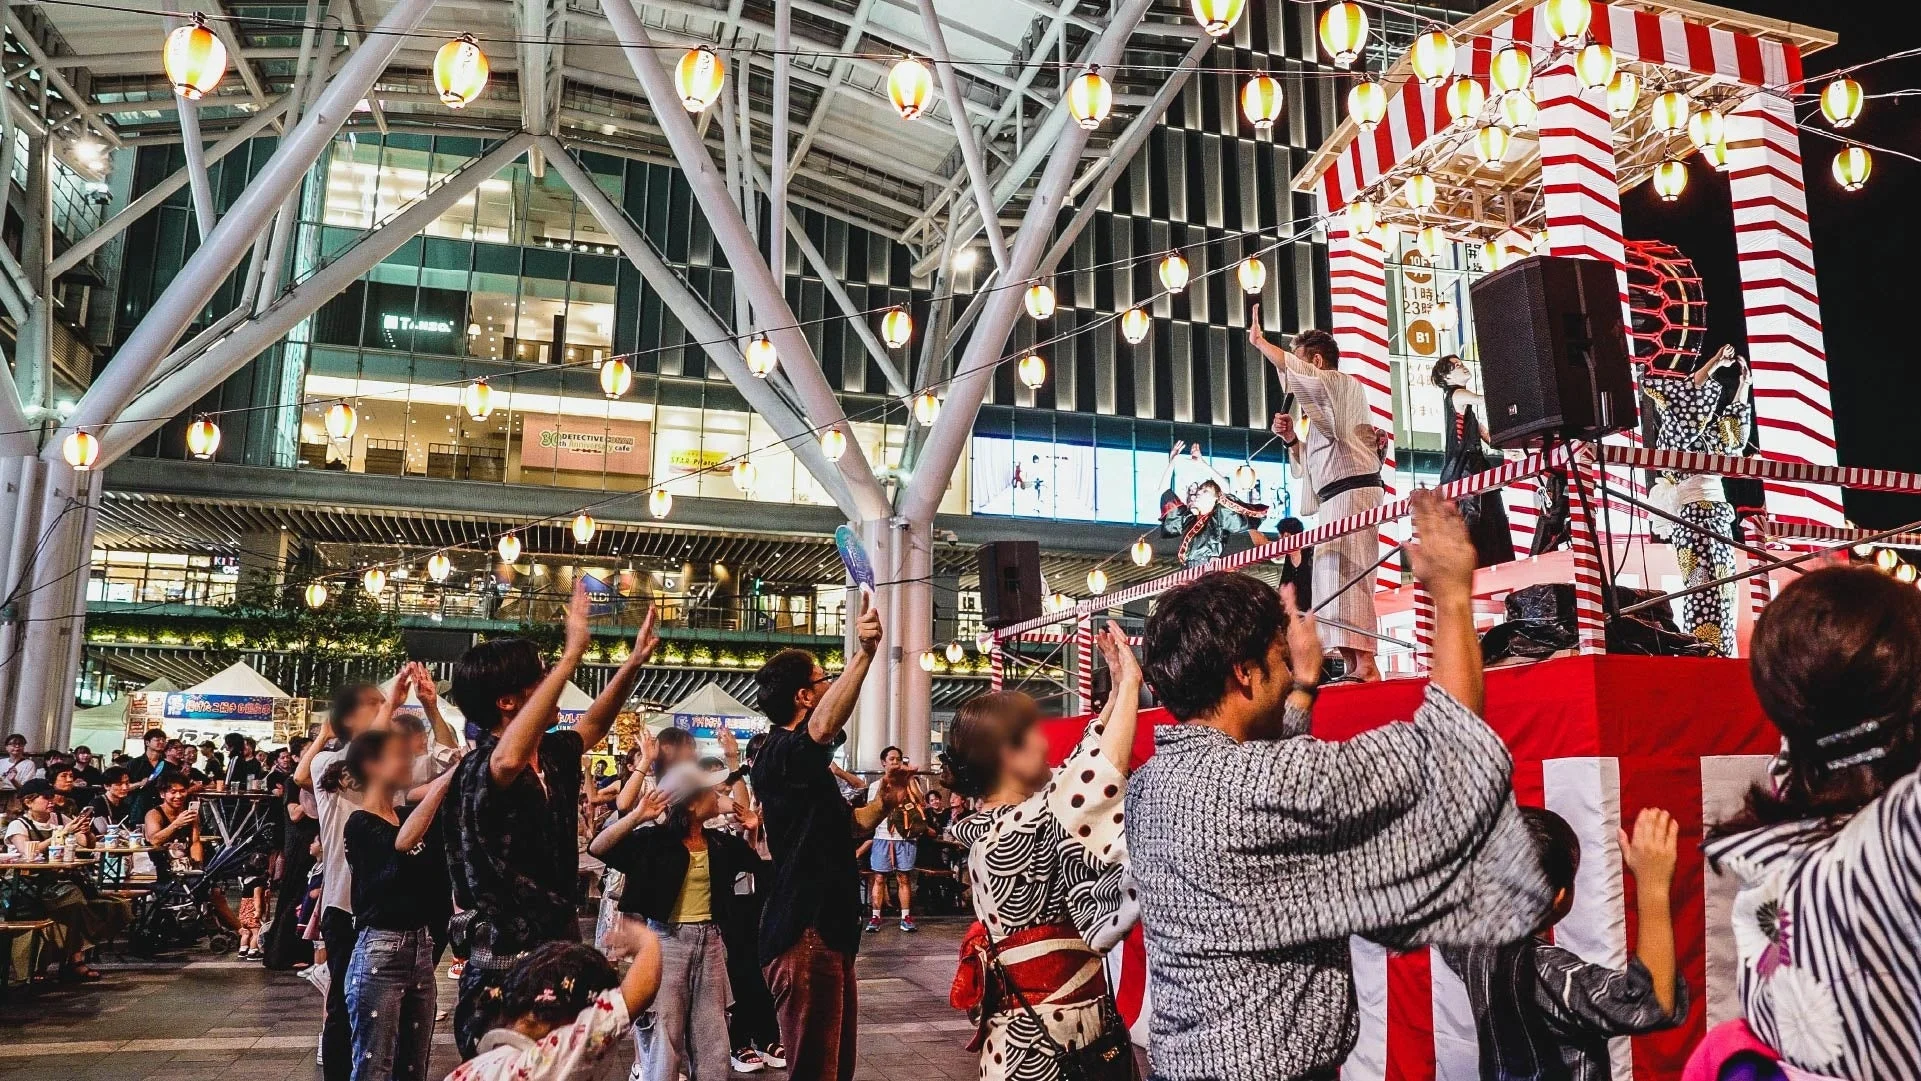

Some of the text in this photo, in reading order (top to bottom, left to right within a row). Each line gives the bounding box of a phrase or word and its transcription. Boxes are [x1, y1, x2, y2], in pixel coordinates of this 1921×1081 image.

[1415, 331, 1430, 344] B1
[562, 433, 604, 443] DETECTIVE
[614, 444, 631, 453] cafe
[693, 458, 719, 468] Piates
[584, 592, 610, 602] ALDI
